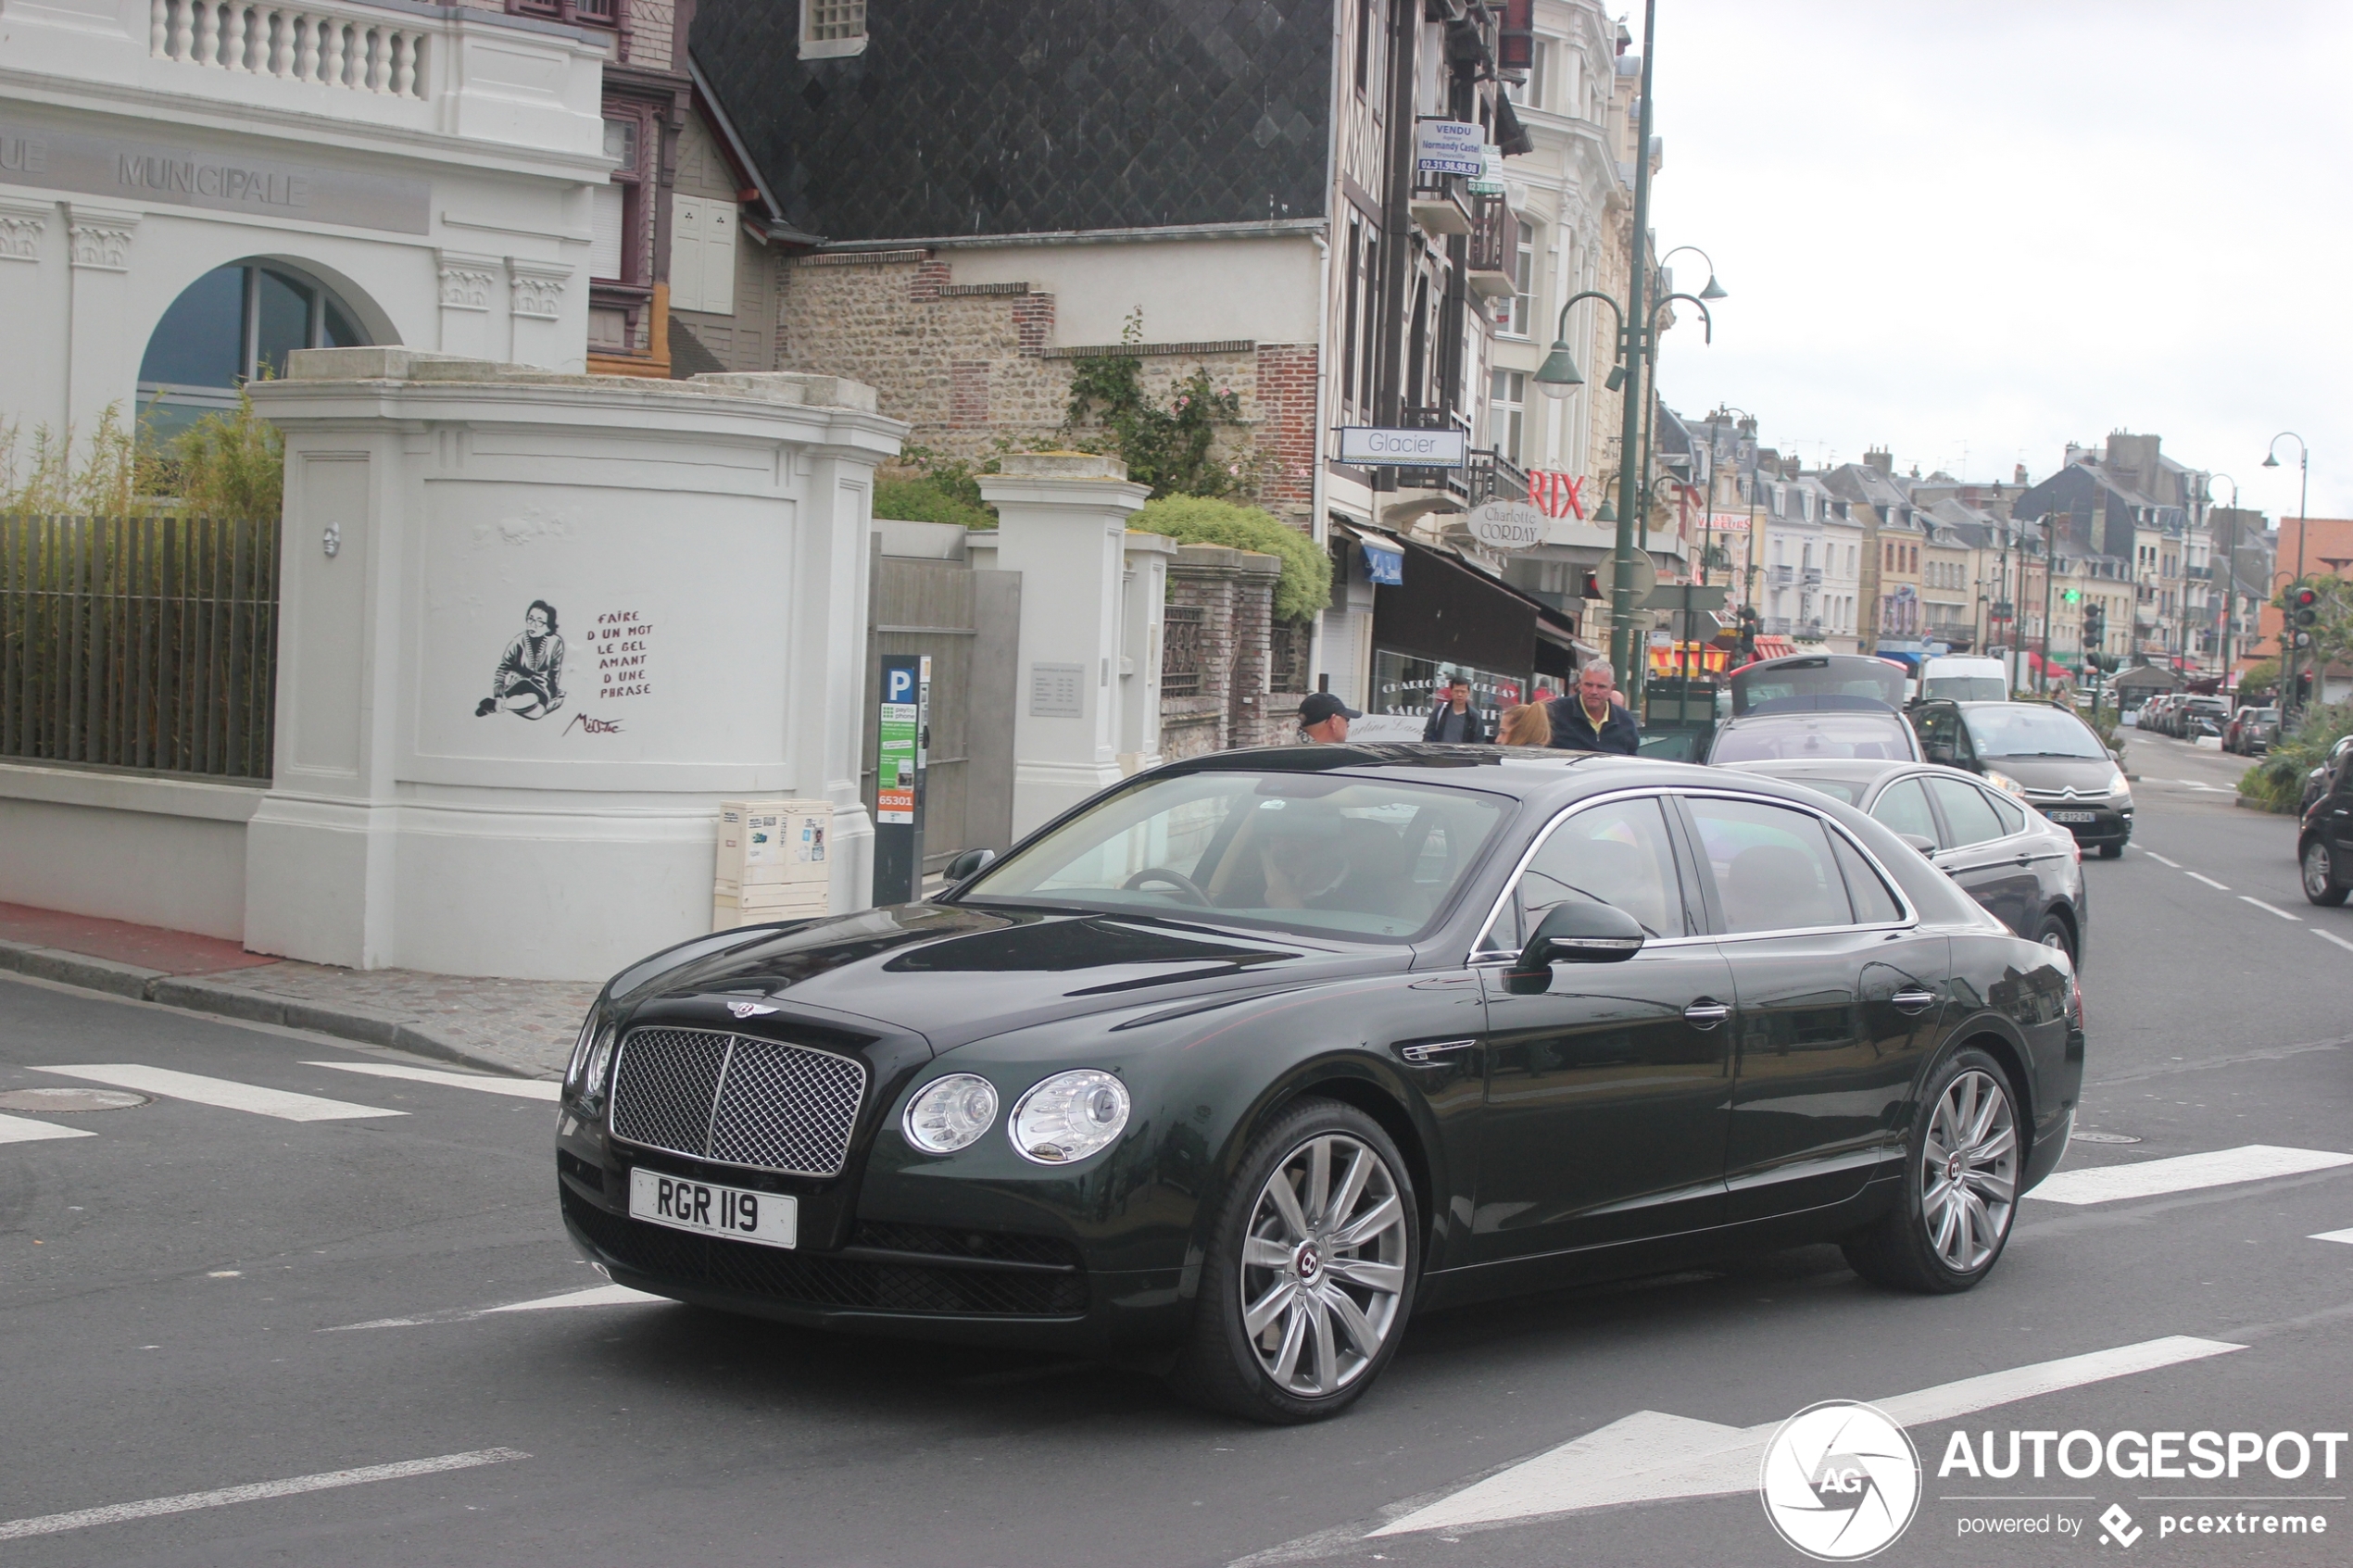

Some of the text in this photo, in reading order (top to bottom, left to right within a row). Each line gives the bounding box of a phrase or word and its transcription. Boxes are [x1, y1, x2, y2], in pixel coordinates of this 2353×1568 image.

[1436, 125, 1471, 135] VENDU
[1422, 140, 1480, 153] Normandy Castel
[1436, 151, 1466, 159] Trouville
[1421, 159, 1478, 174] 02.31.98.98.98
[118, 153, 308, 208] MUNICIPALE
[1368, 433, 1436, 453] Glacier
[1484, 507, 1537, 524] Charlotte
[1697, 515, 1751, 530] VPEURS
[1480, 523, 1538, 543] CORDAY
[587, 624, 653, 640] D UN MOT
[598, 641, 647, 655] LE GEL
[599, 654, 648, 670] AMANT
[604, 670, 646, 684] D UNE
[600, 684, 651, 698] PHRASE
[889, 671, 911, 700] P
[1382, 678, 1519, 699] CHARLOTT ORDAY
[895, 712, 915, 721] phone
[1480, 709, 1501, 721] TH
[1390, 717, 1425, 735] Lam
[879, 796, 912, 806] 65301
[658, 1178, 758, 1233] RGR 119
